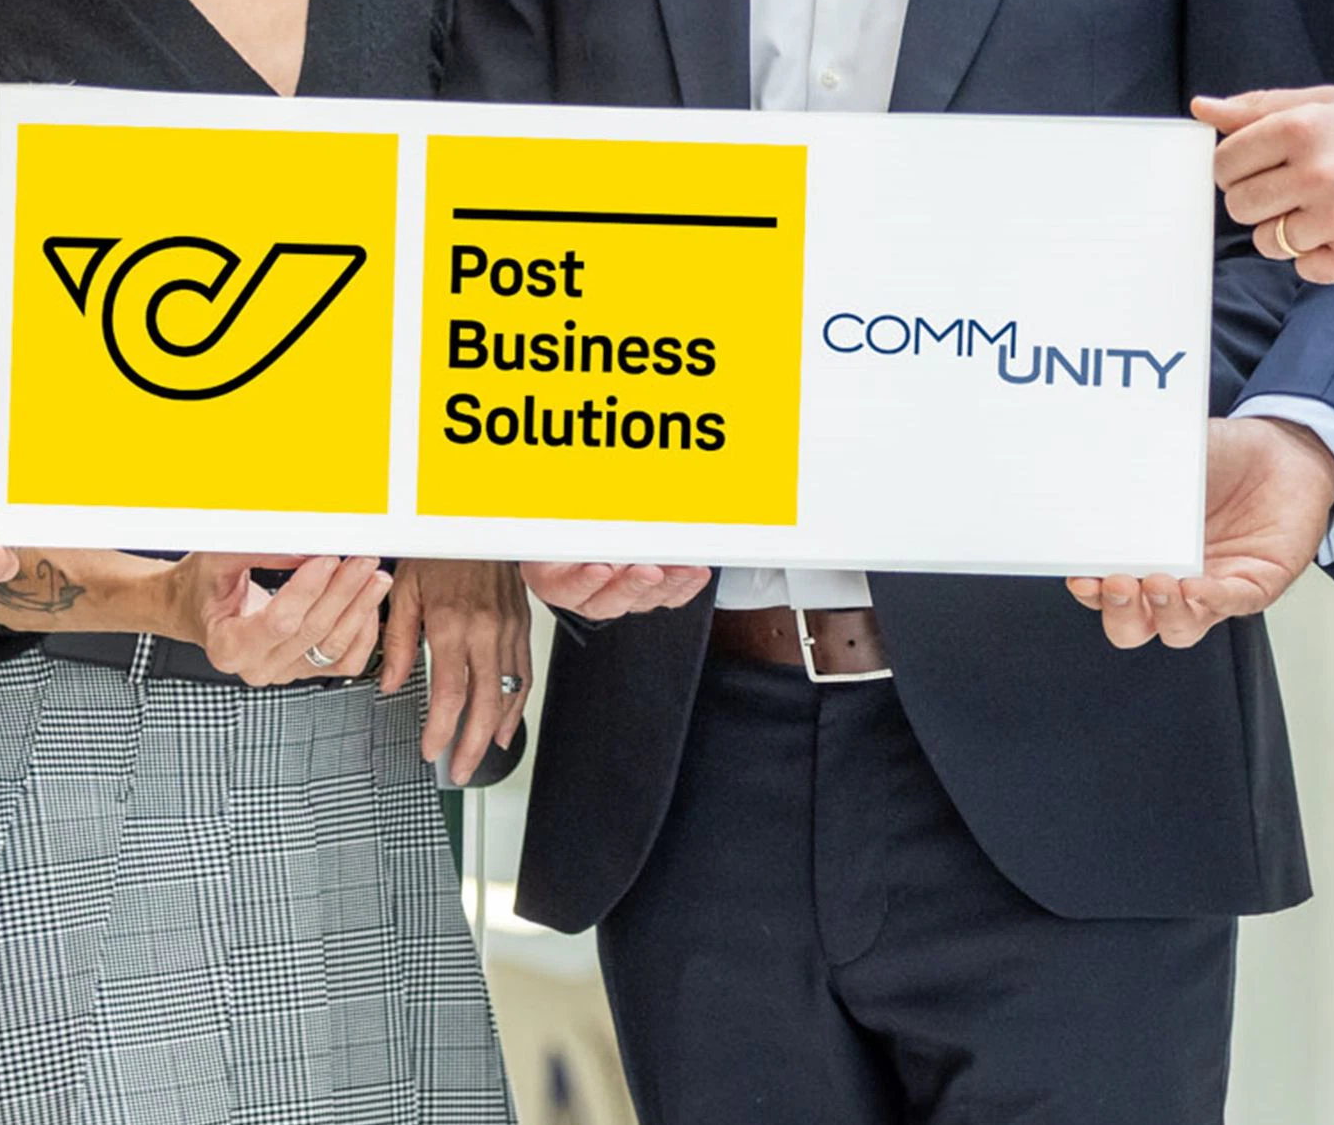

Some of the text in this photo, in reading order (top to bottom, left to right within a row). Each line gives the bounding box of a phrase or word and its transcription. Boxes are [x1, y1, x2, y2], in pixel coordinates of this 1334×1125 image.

[450, 244, 585, 299] Post
[448, 319, 716, 377] Business
[443, 393, 727, 452] Solutions
